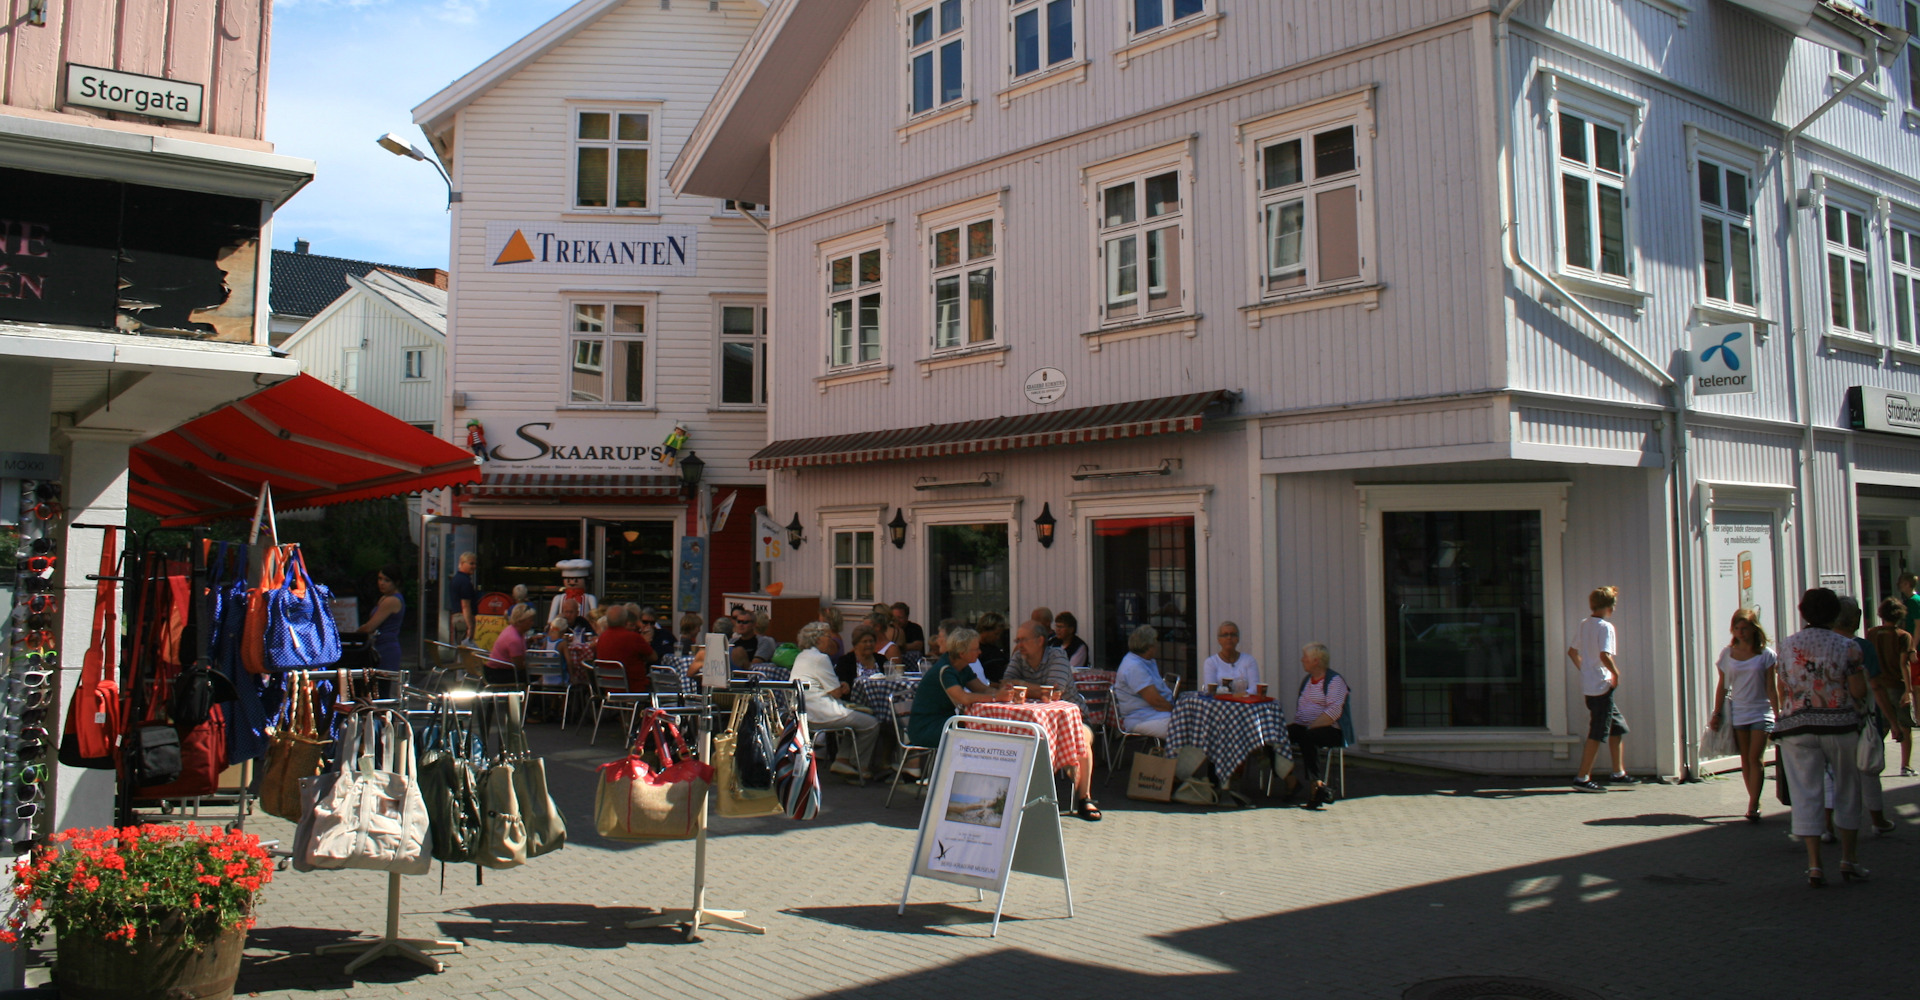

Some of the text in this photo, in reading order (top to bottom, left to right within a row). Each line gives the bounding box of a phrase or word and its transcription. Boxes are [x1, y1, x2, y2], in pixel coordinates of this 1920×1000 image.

[80, 76, 189, 112] Storgata
[536, 232, 688, 266] TREKANTEN
[1698, 375, 1747, 388] telenor
[489, 422, 663, 462] SKAARUP'S
[960, 744, 986, 754] THEODOR
[987, 747, 1018, 757] KITTELSEN
